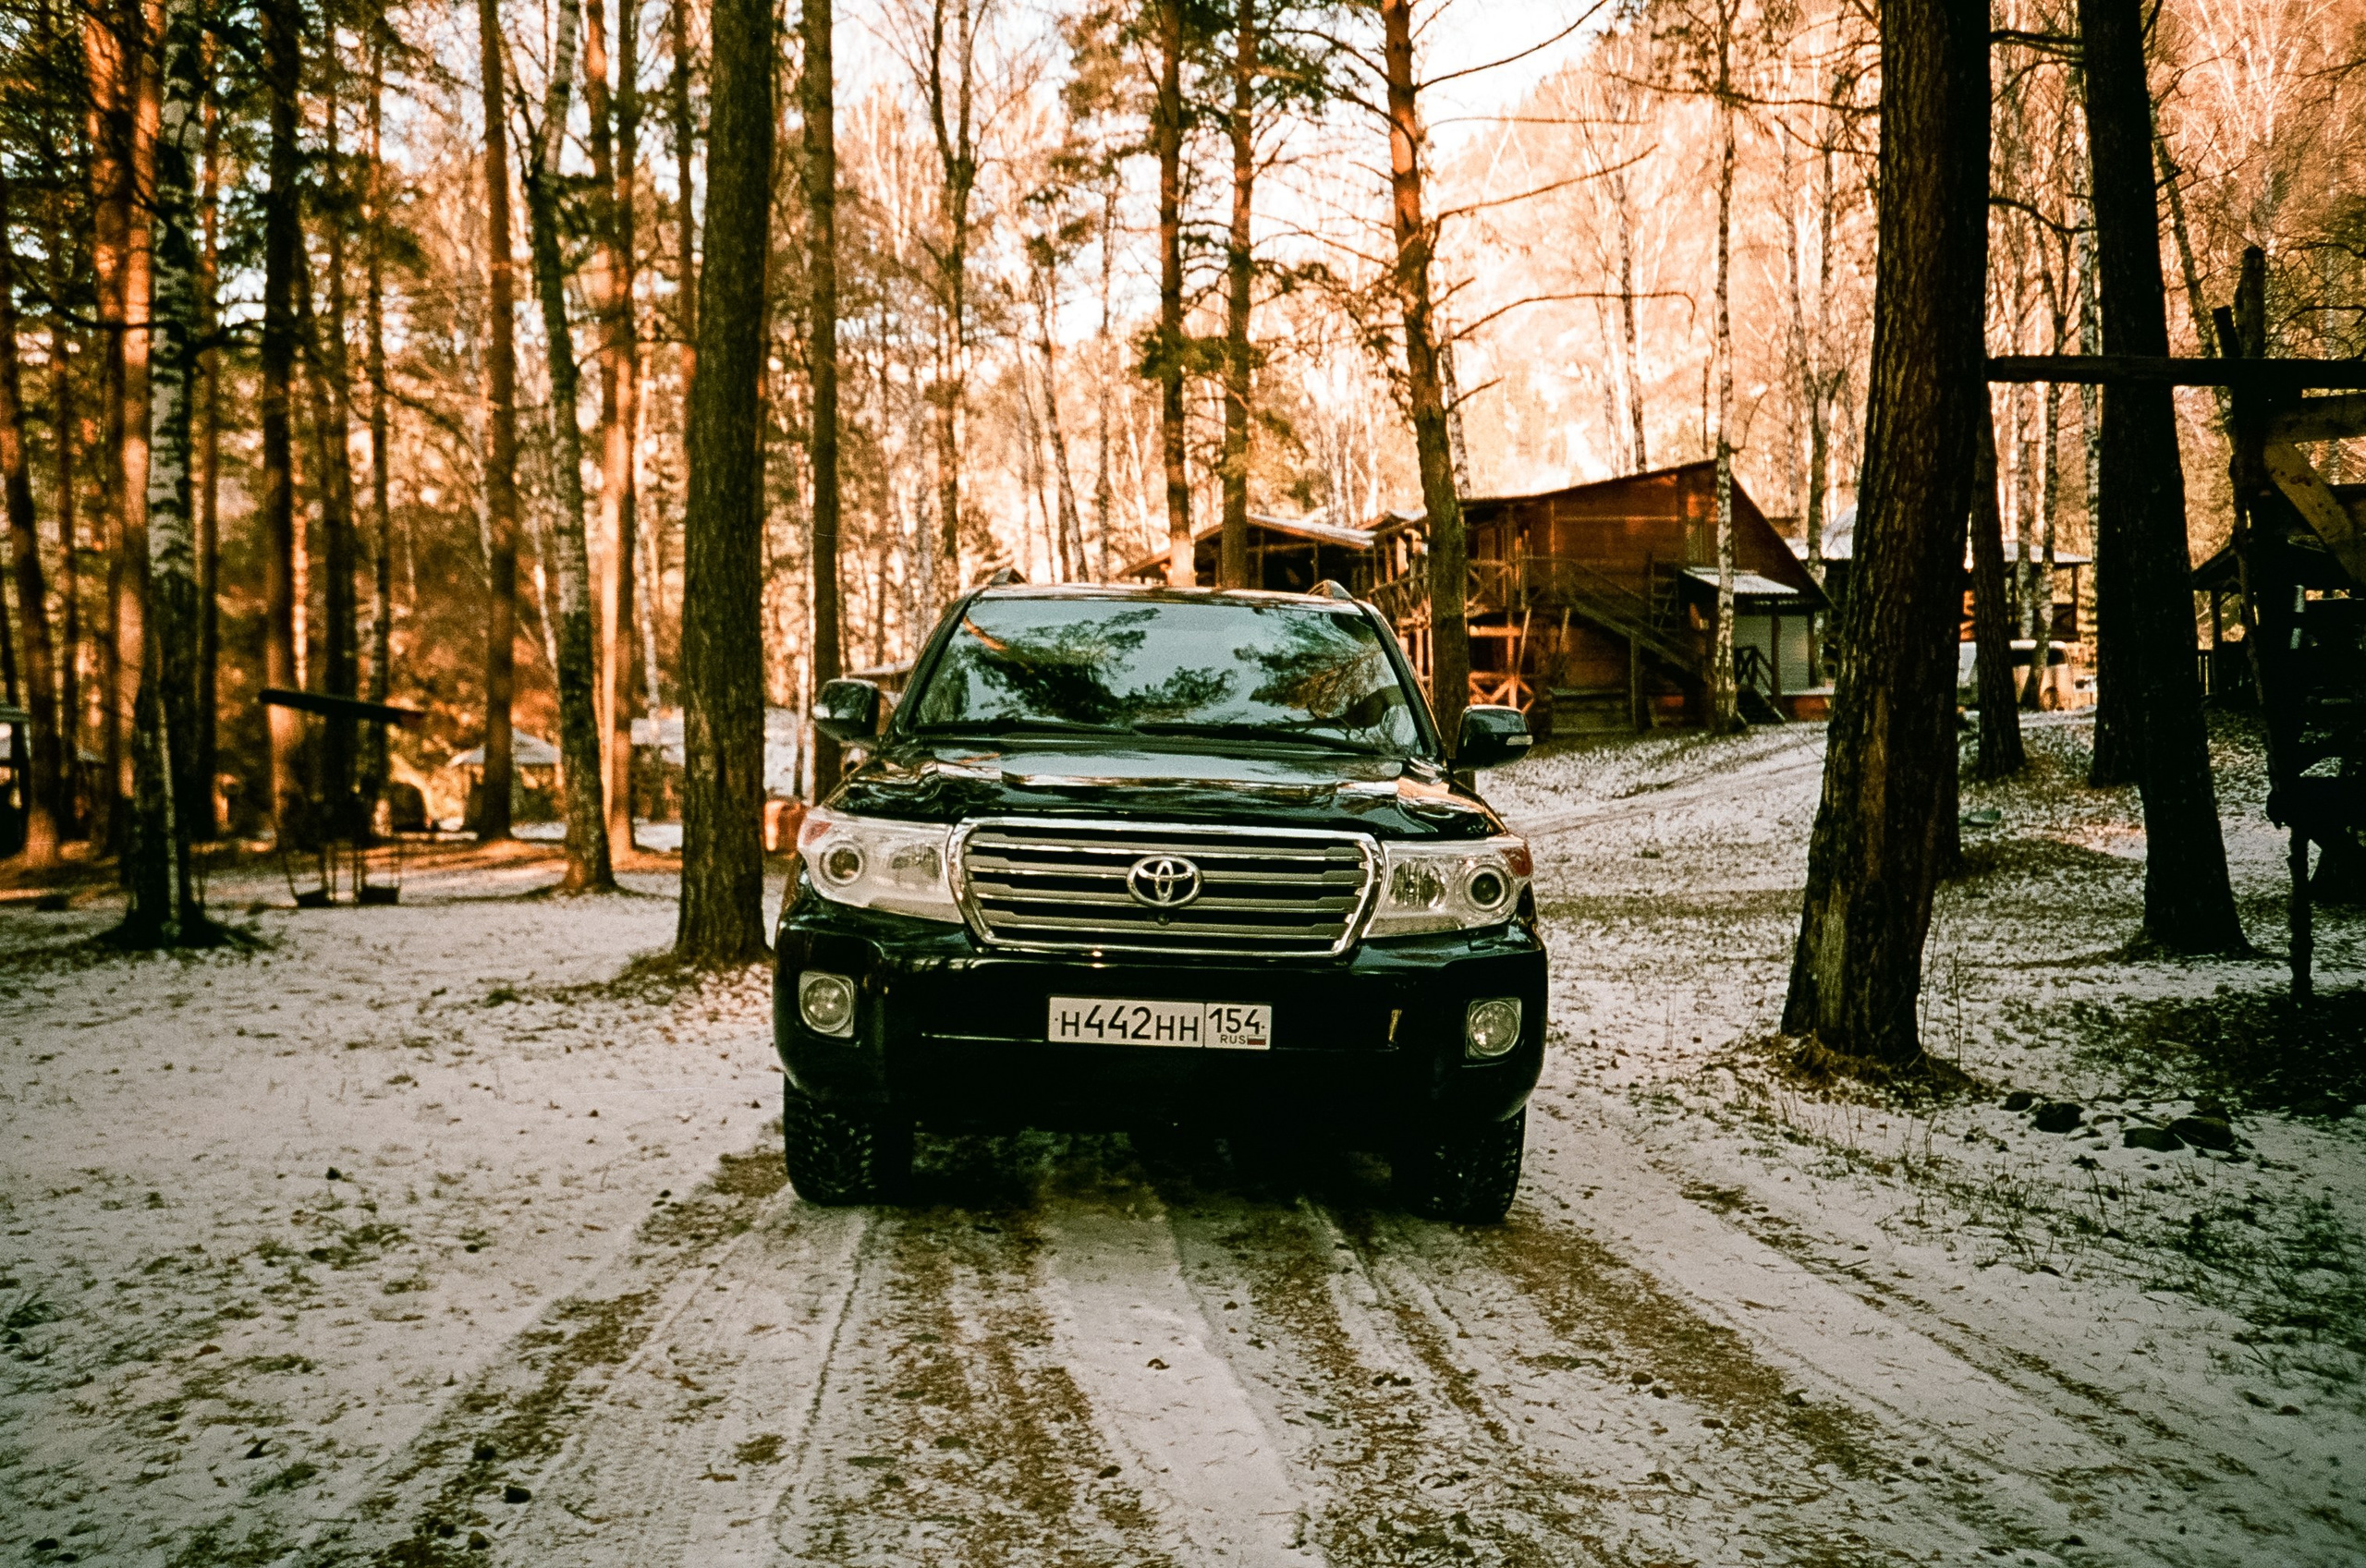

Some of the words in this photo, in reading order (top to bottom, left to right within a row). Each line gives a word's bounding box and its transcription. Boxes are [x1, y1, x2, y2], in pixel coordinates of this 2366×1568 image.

[1060, 1004, 1199, 1041] H442HH
[1208, 1007, 1261, 1035] 154
[1220, 1034, 1247, 1045] RUS
